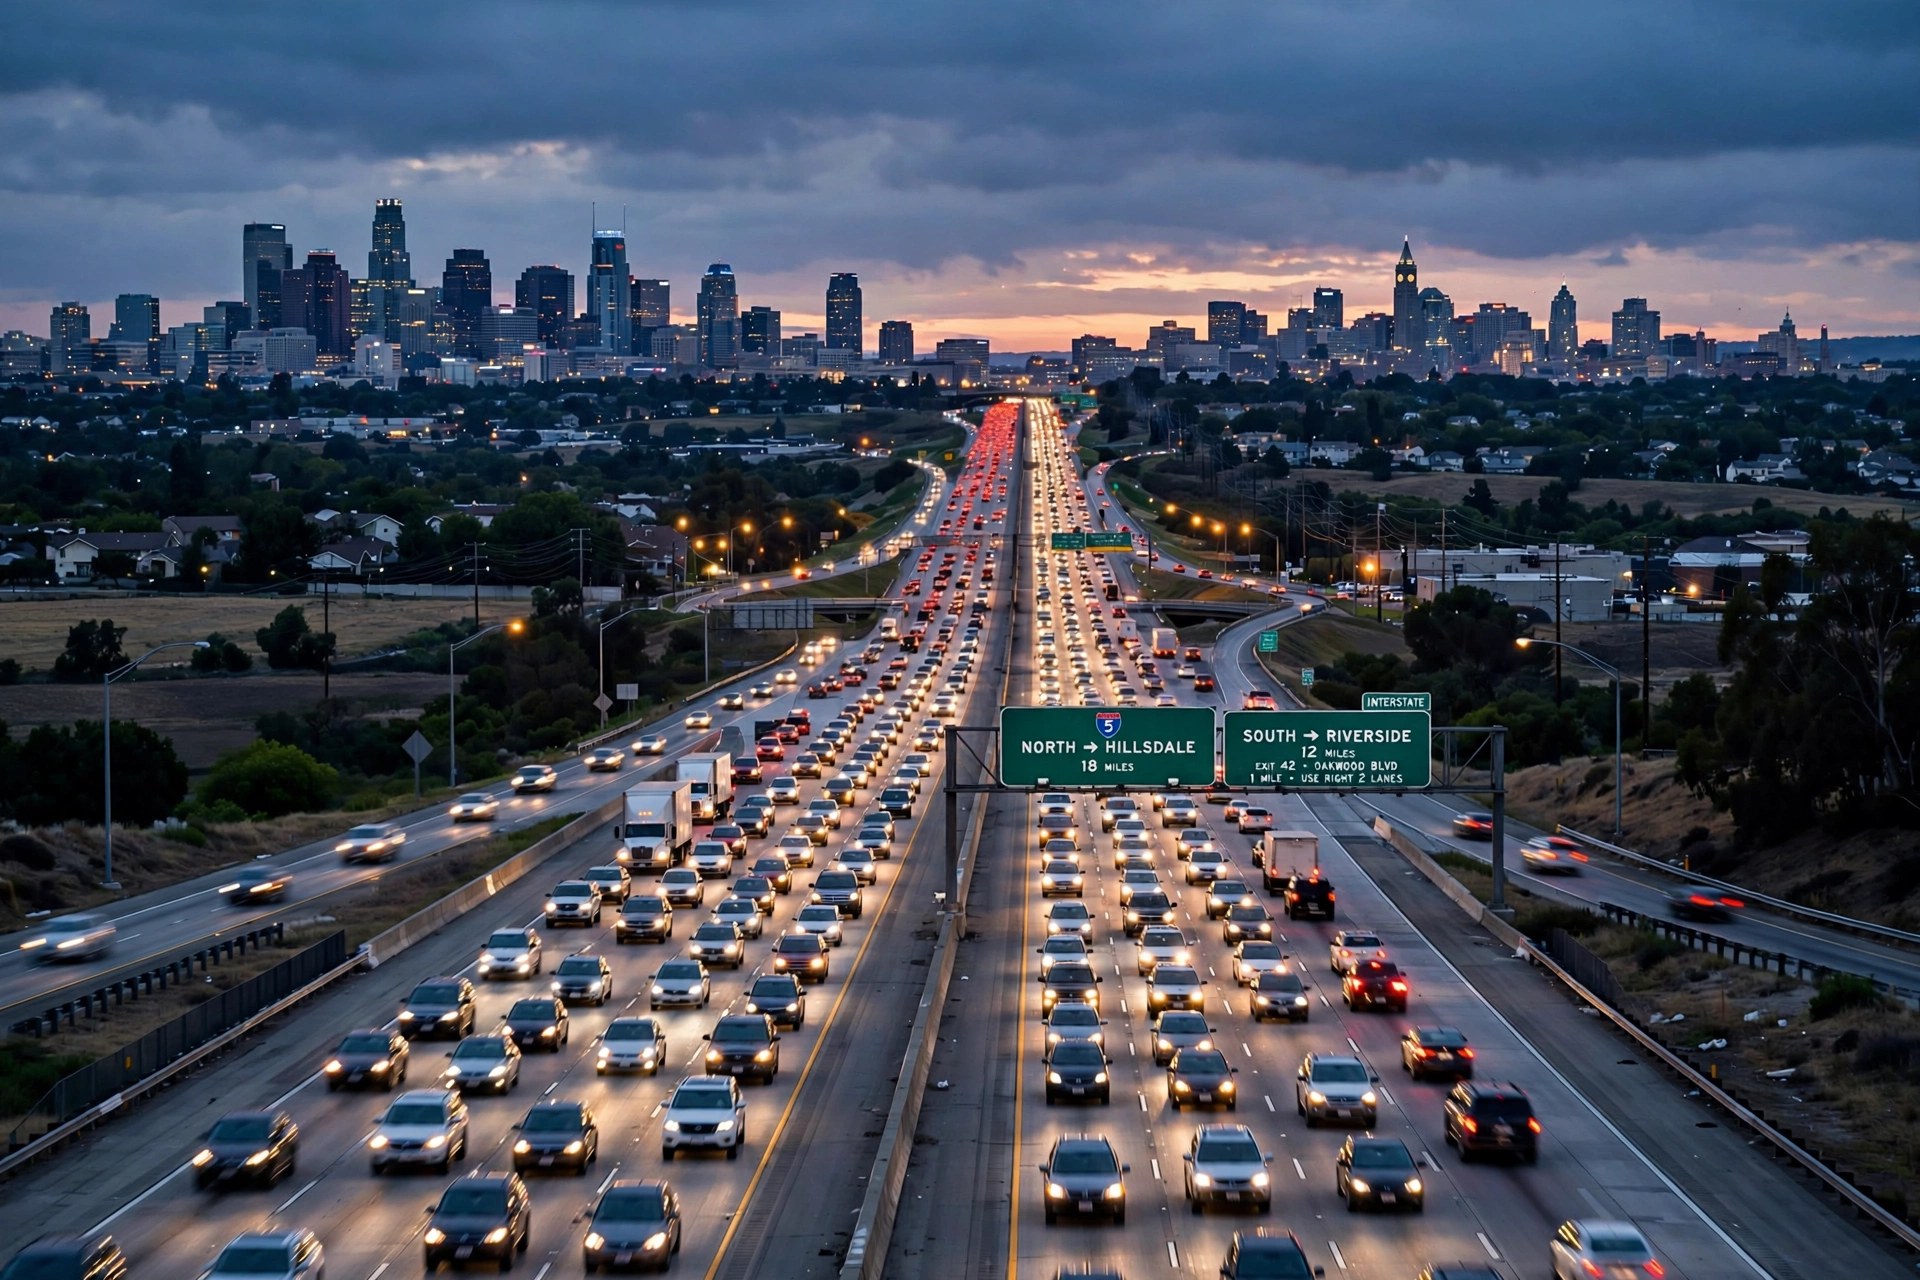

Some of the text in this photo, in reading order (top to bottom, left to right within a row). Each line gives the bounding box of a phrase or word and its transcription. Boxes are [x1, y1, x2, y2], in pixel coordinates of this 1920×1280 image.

[1368, 698, 1424, 707] INTERSTATE
[1104, 719, 1113, 733] 5
[1244, 730, 1411, 742] SOUTH RIVERSIDE
[1022, 741, 1195, 753] NORTH HILLSDALE
[1302, 746, 1356, 758] 12 MILES
[1082, 760, 1134, 772] 18 MILES
[1255, 761, 1397, 771] EXIT 42 OAKWOOD BLVD
[1250, 773, 1402, 783] 1 MILE USE RIGHT 2 LANES
